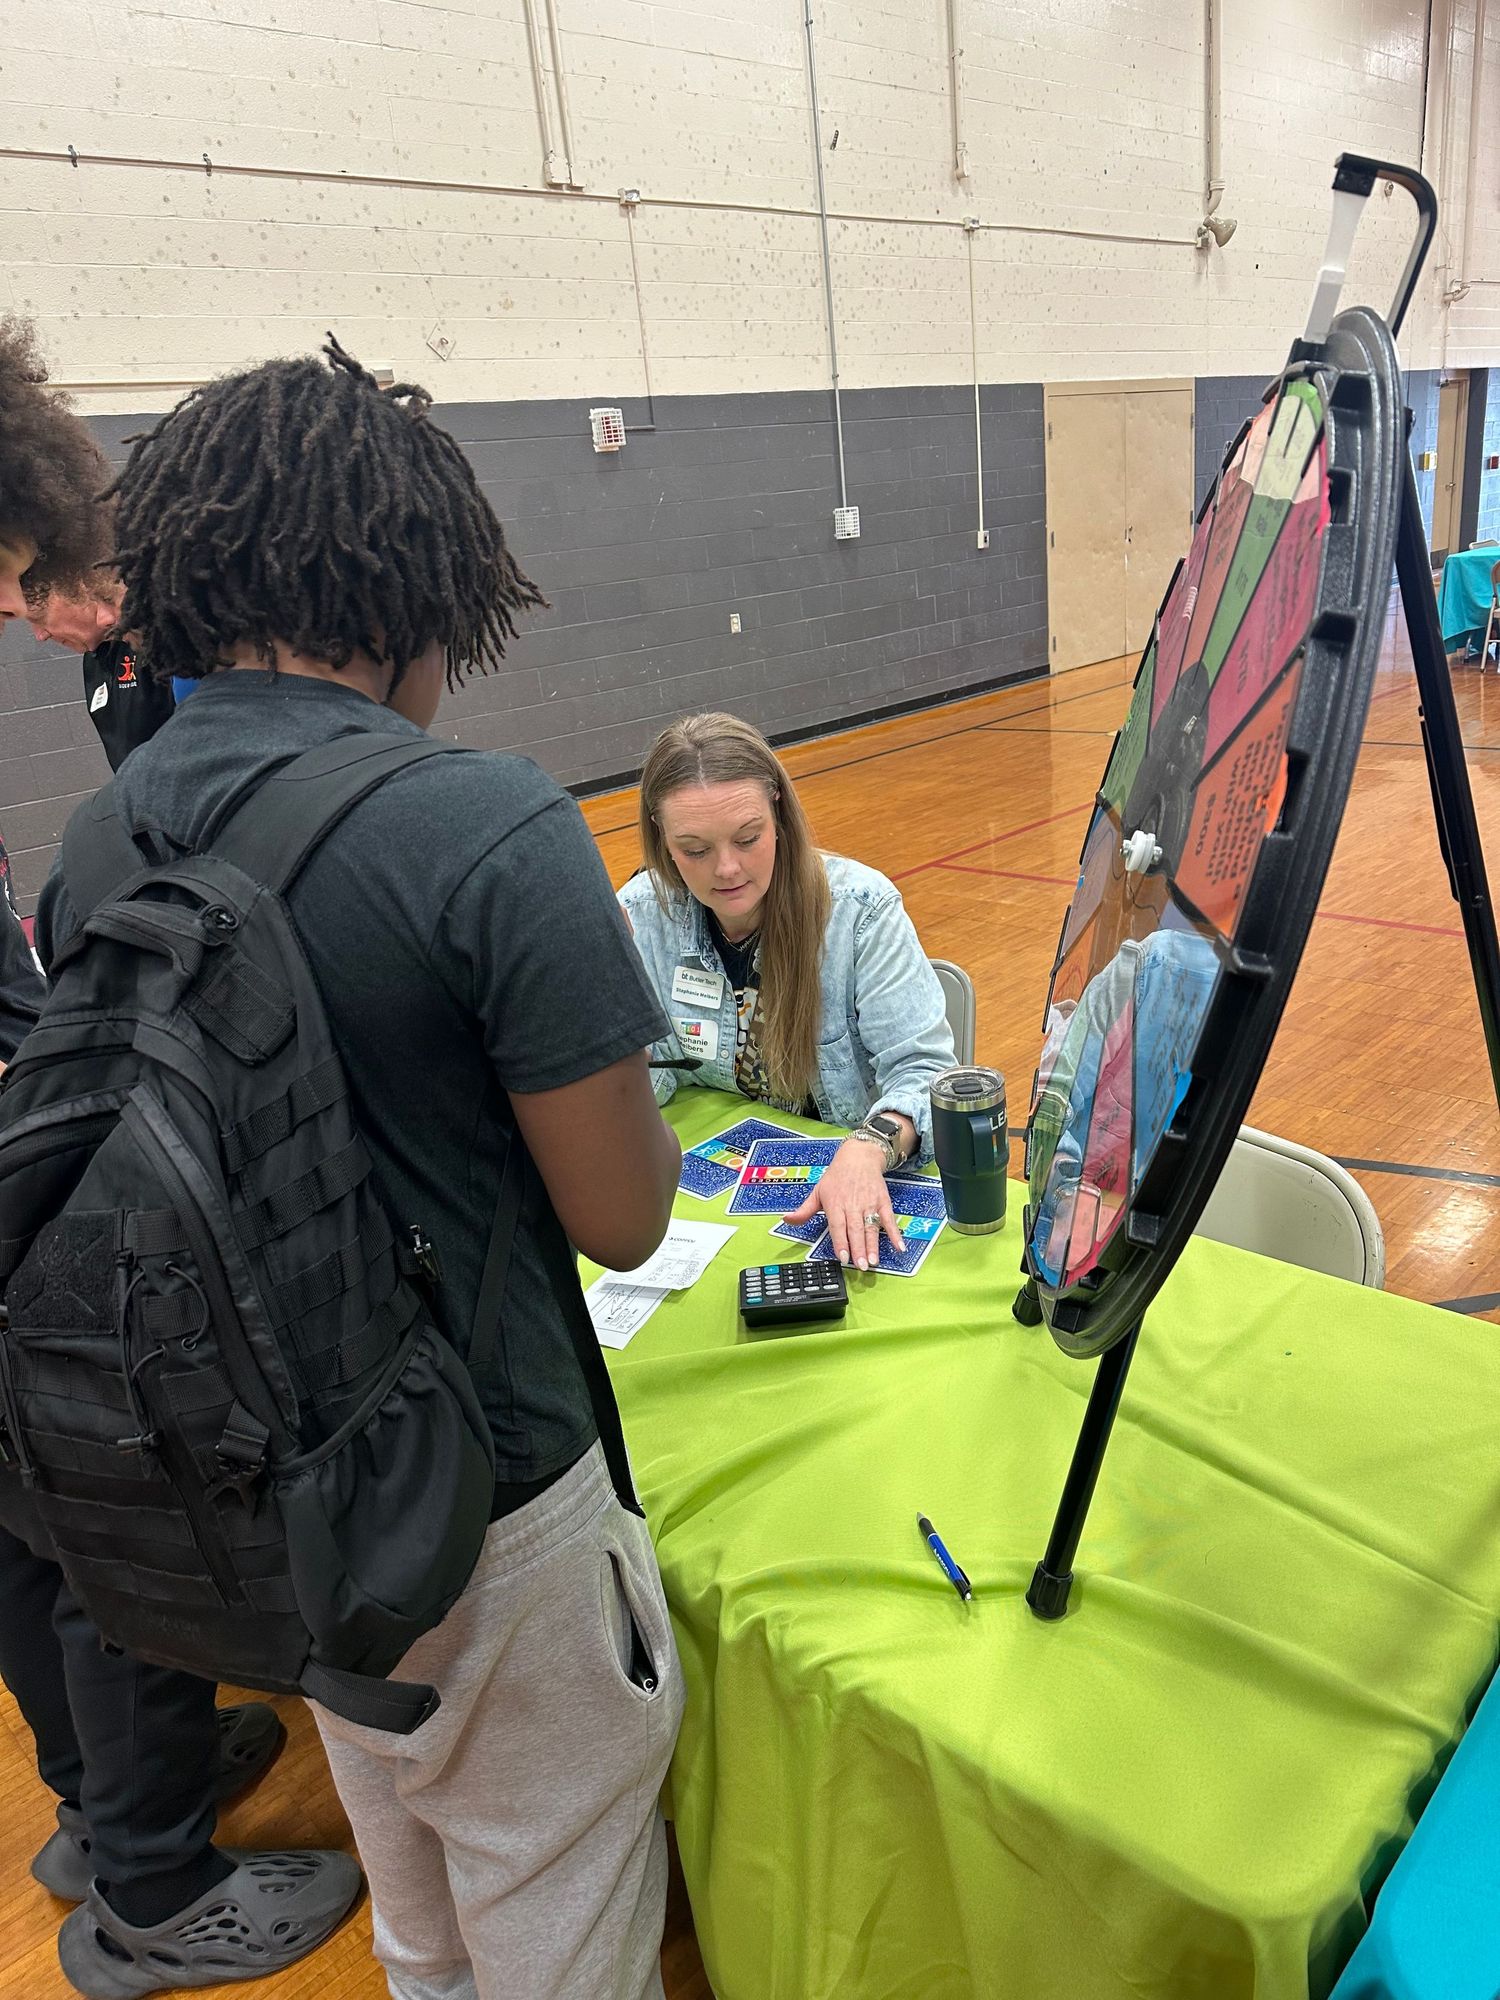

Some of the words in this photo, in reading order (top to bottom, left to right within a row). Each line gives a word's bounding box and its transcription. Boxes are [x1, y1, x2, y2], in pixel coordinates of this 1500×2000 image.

[705, 978, 717, 986] Tech
[676, 987, 699, 997] Stephanie
[677, 1034, 709, 1047] tephanie
